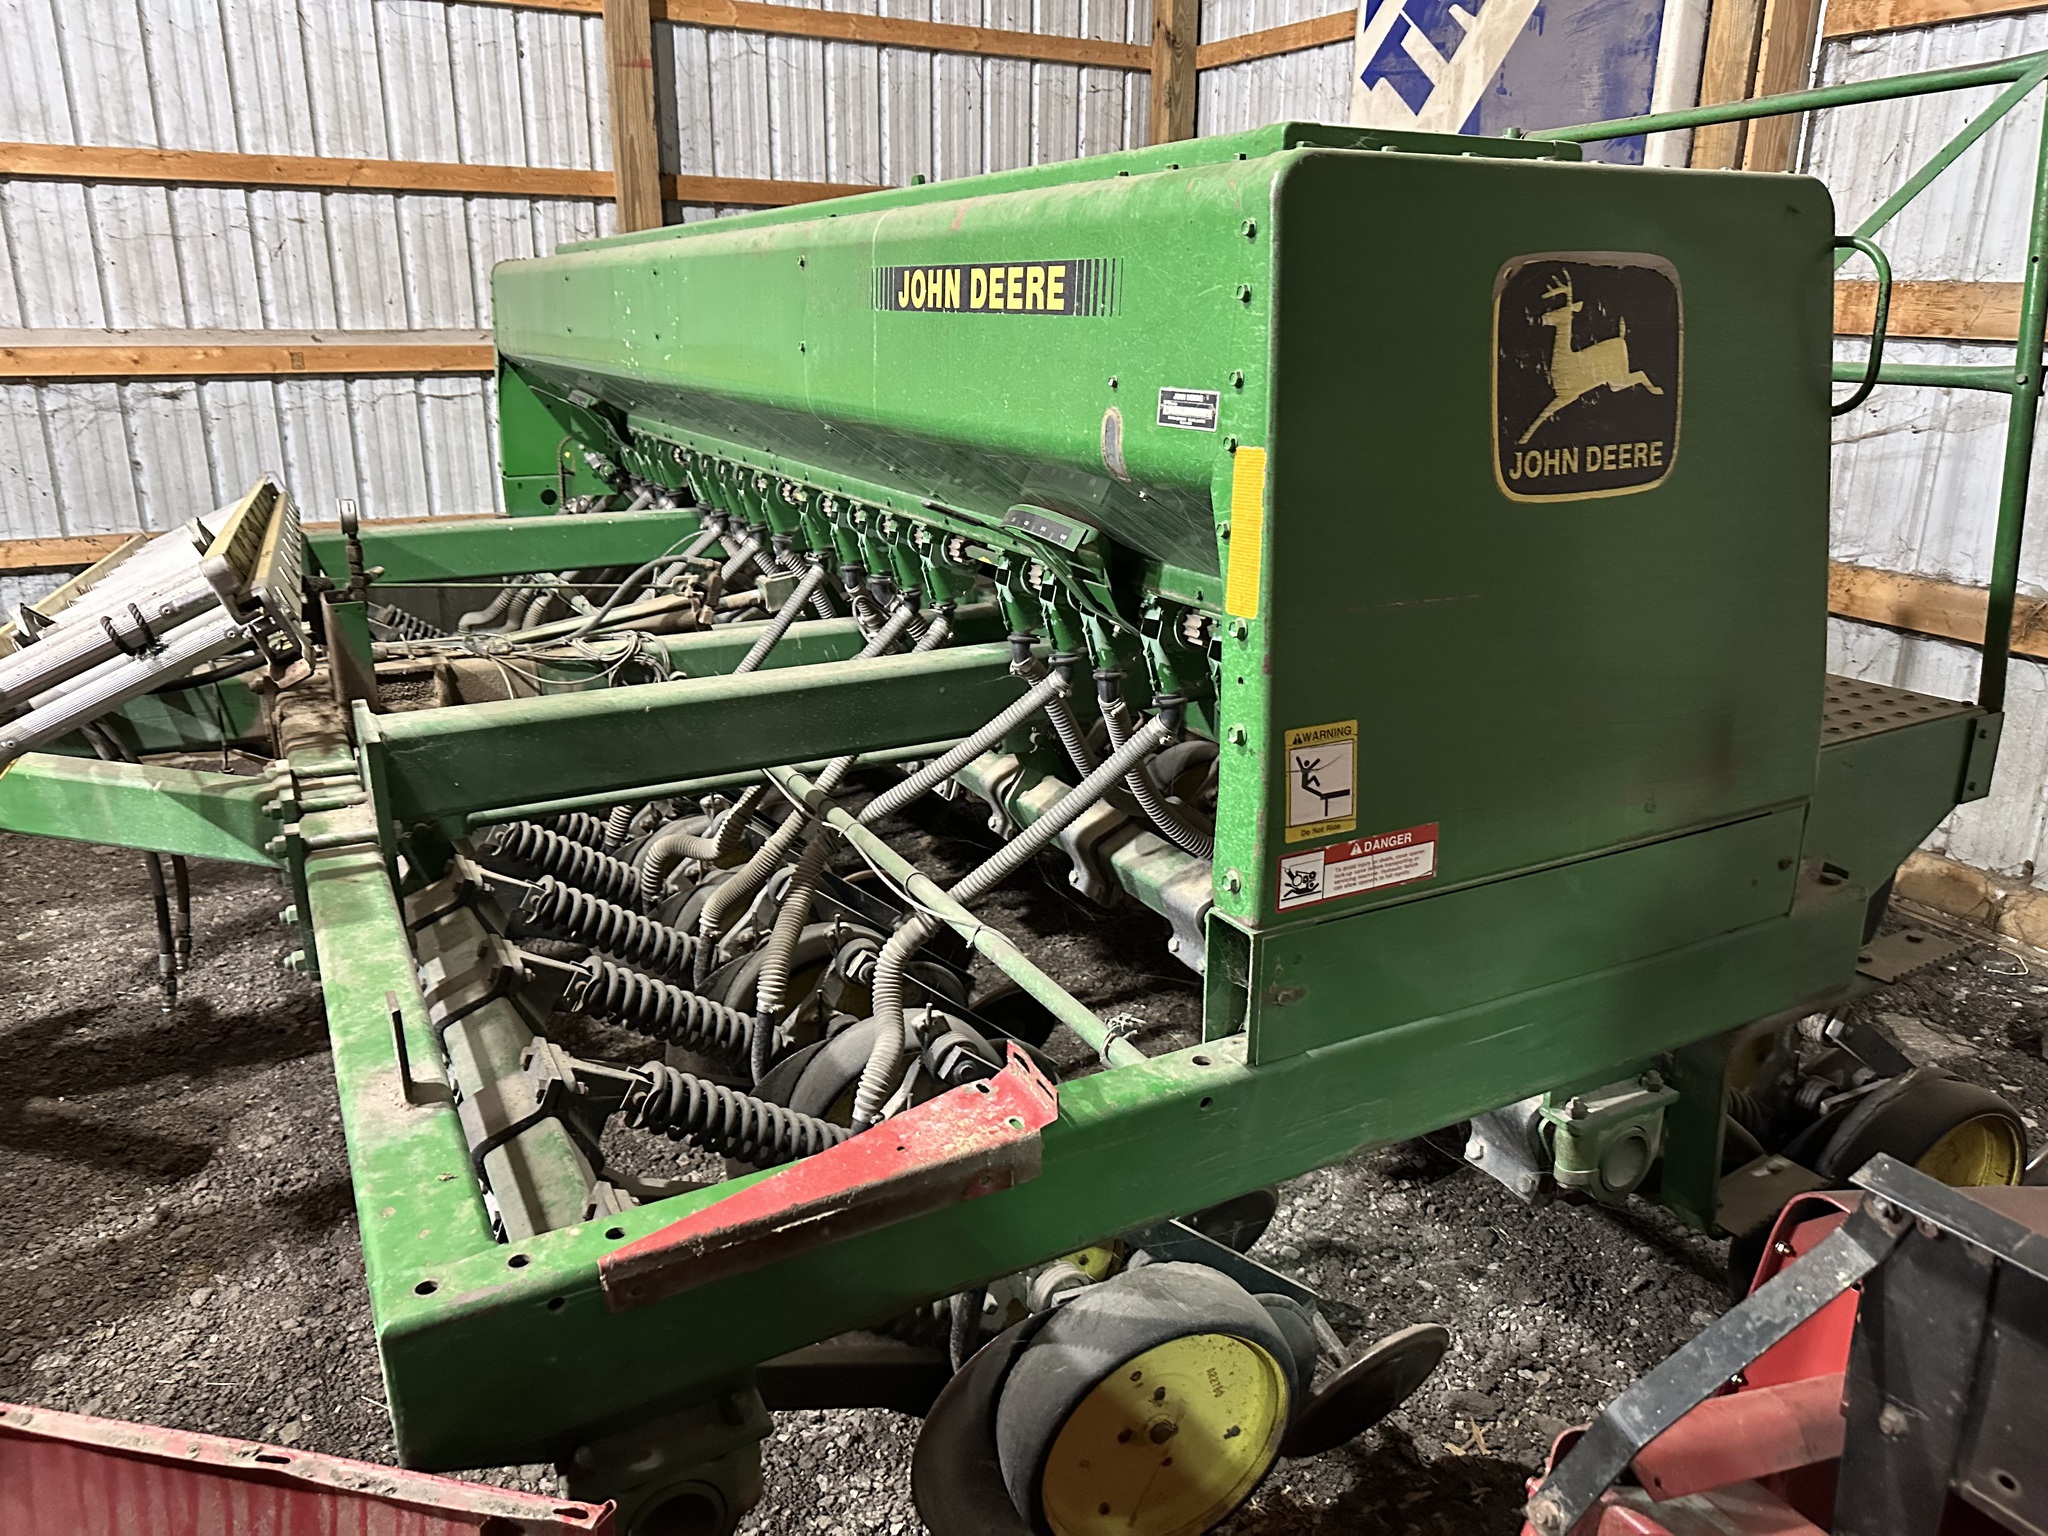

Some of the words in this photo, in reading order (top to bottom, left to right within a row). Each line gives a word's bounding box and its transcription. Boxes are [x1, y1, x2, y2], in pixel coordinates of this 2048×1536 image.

[898, 269, 961, 308] JOHN
[969, 265, 1066, 310] DEERE
[1509, 447, 1579, 480] JOHN
[1585, 441, 1663, 473] DEERE
[1302, 725, 1352, 742] WARNING
[1300, 829, 1311, 837] Do
[1312, 826, 1325, 835] Not
[1326, 823, 1341, 832] Ride
[1364, 832, 1412, 852] DANGER
